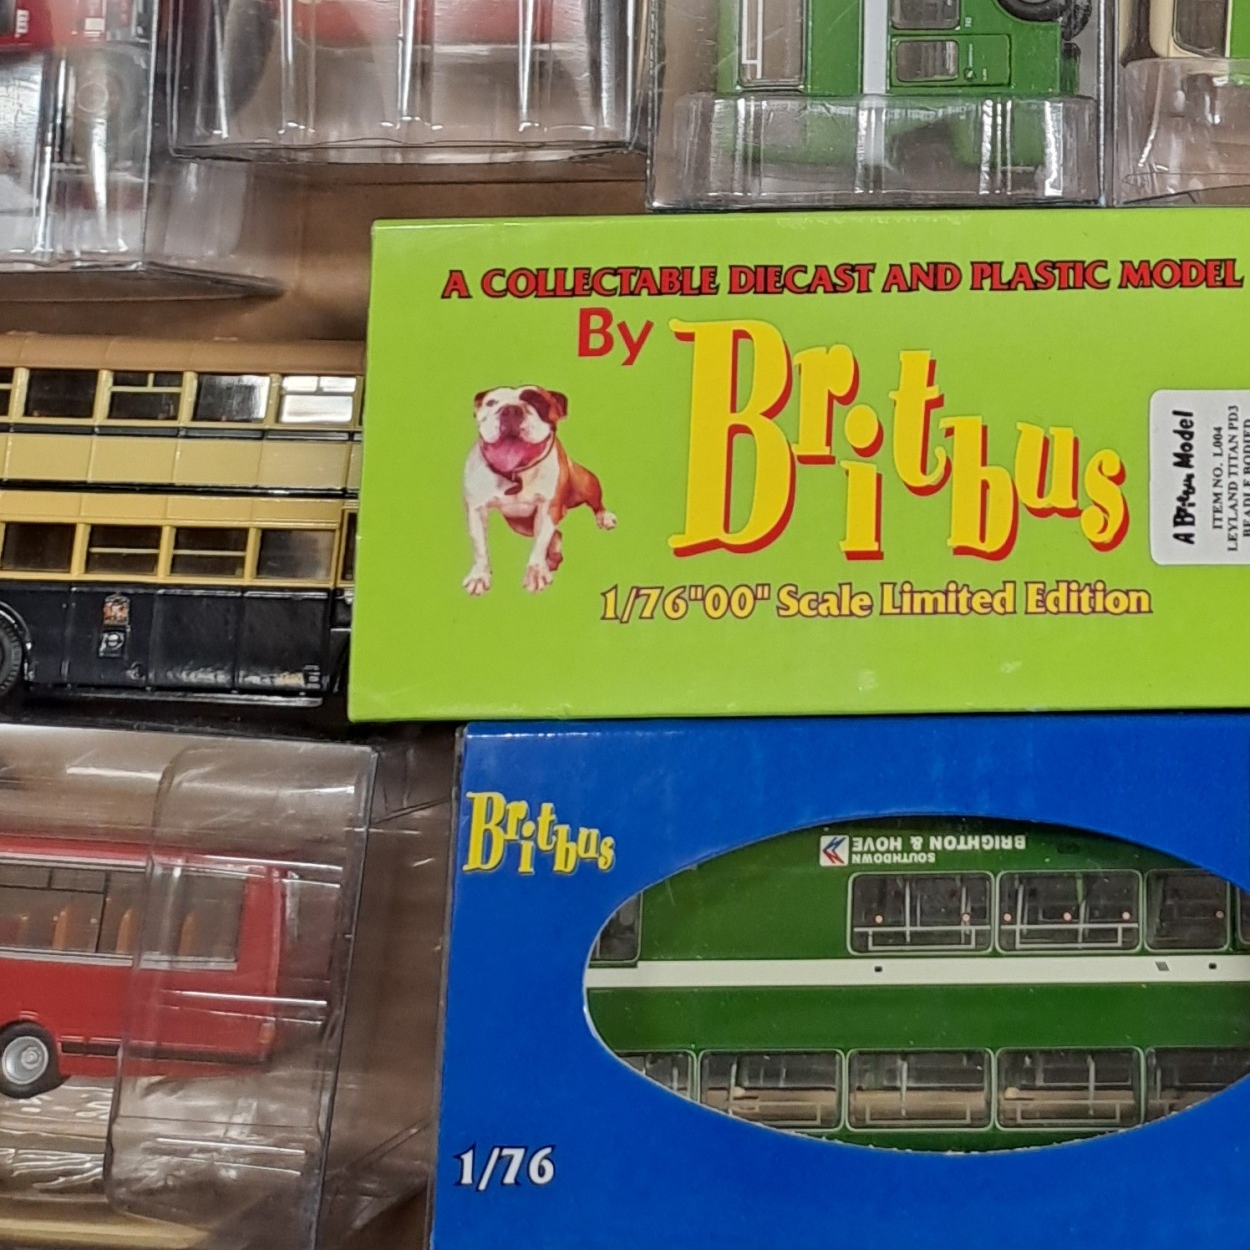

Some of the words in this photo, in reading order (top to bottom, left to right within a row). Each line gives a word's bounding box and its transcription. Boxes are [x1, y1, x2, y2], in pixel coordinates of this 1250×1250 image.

[441, 269, 472, 299] A
[481, 265, 720, 299] COLLECTABLE
[728, 263, 877, 295] DIECAST
[882, 262, 962, 293] AND
[969, 259, 1111, 292] PLASTIC
[1118, 258, 1245, 290] MODEL
[577, 307, 654, 366] By
[1228, 405, 1239, 430] PD3
[668, 318, 1130, 561] Britbus
[1228, 434, 1238, 478] TITAN
[1228, 482, 1238, 551] LEYLAND
[777, 583, 874, 619] Scale
[879, 581, 1016, 617] Limited
[1024, 580, 1152, 615] Edition
[463, 791, 615, 875] Britbus
[852, 836, 901, 851] HOVE
[910, 836, 923, 850] &
[930, 835, 1026, 850] BRIGHTON
[852, 852, 935, 864] SOUTHDOWN
[453, 1143, 556, 1192] 1/76
